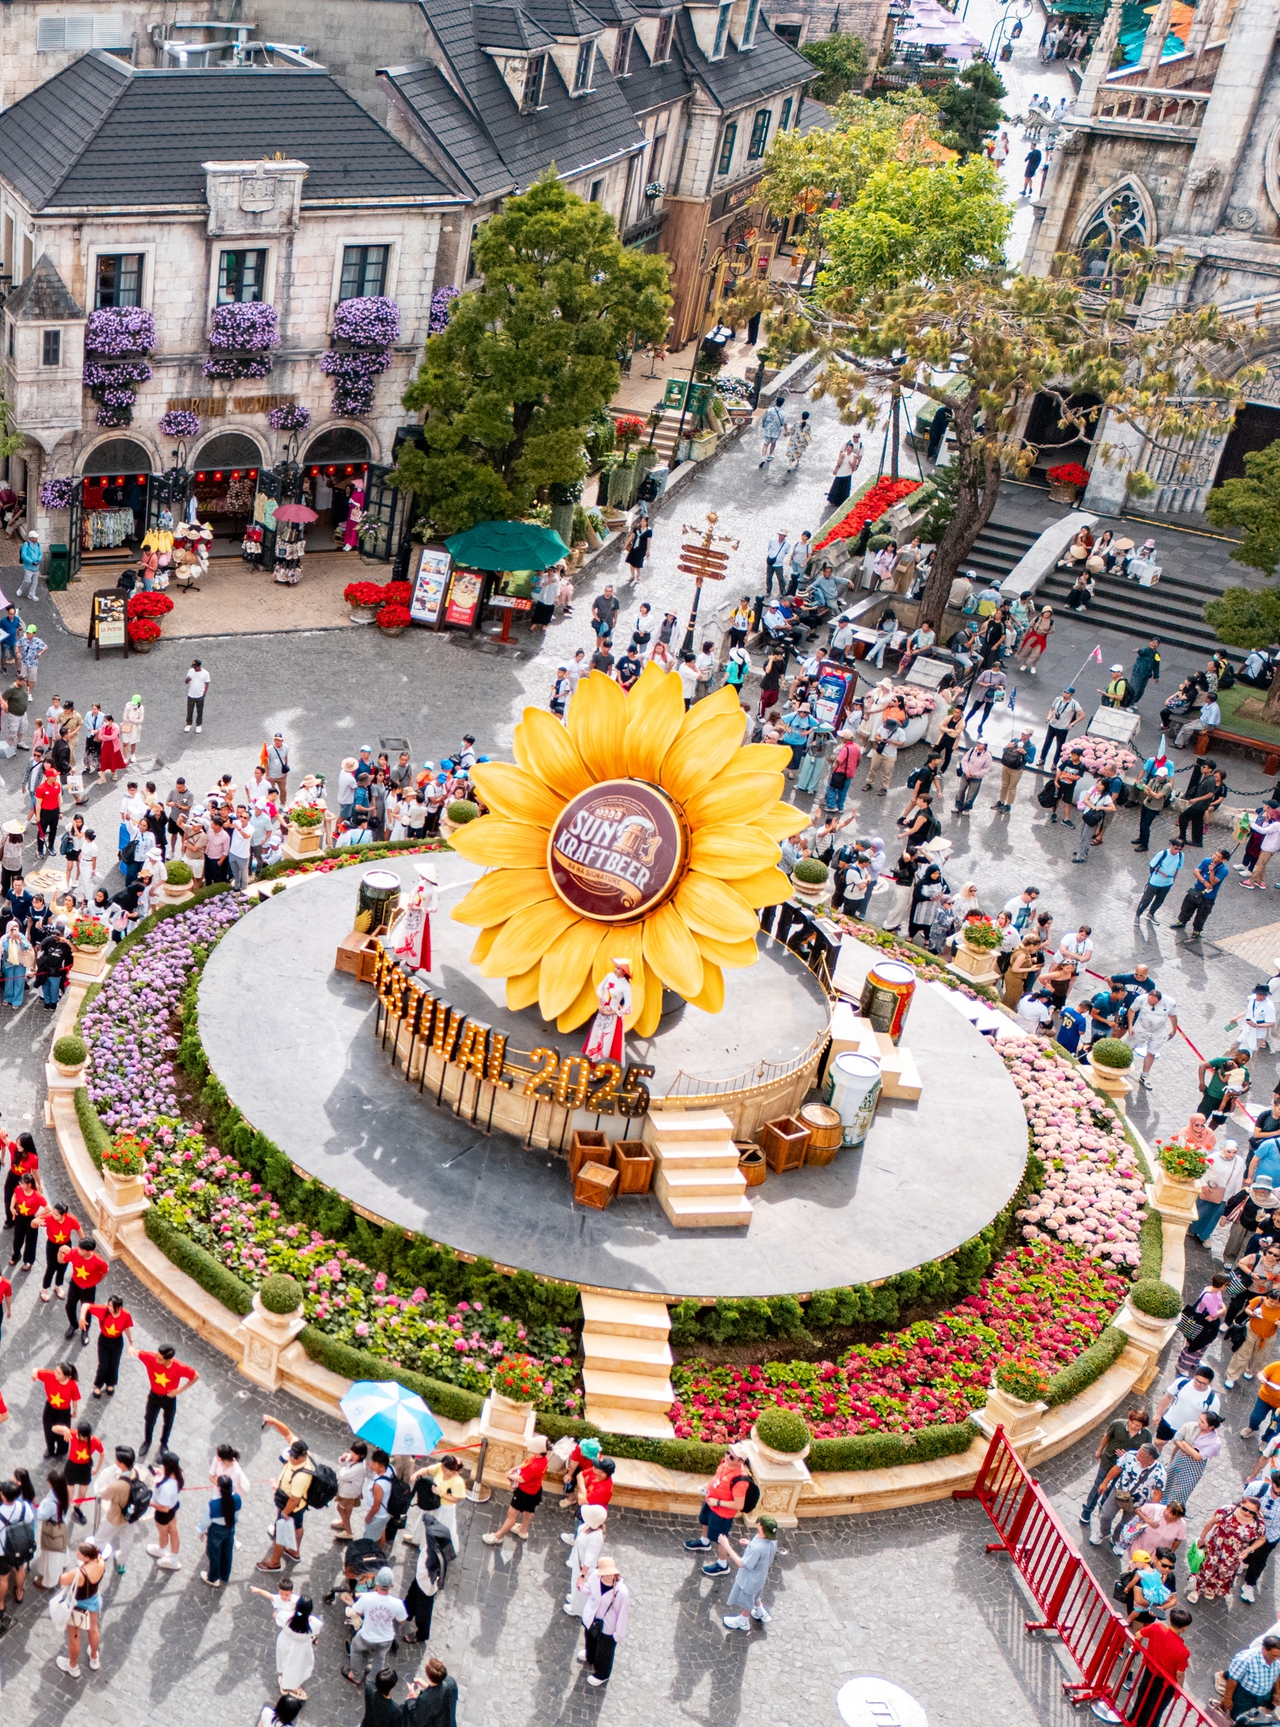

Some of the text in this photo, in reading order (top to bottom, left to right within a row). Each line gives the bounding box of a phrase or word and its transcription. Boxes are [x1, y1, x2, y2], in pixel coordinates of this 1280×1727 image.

[569, 809, 617, 847] SUN
[556, 830, 650, 890] KRAFTBEER
[585, 869, 622, 886] SIGNATURE
[523, 1046, 656, 1118] 2025
